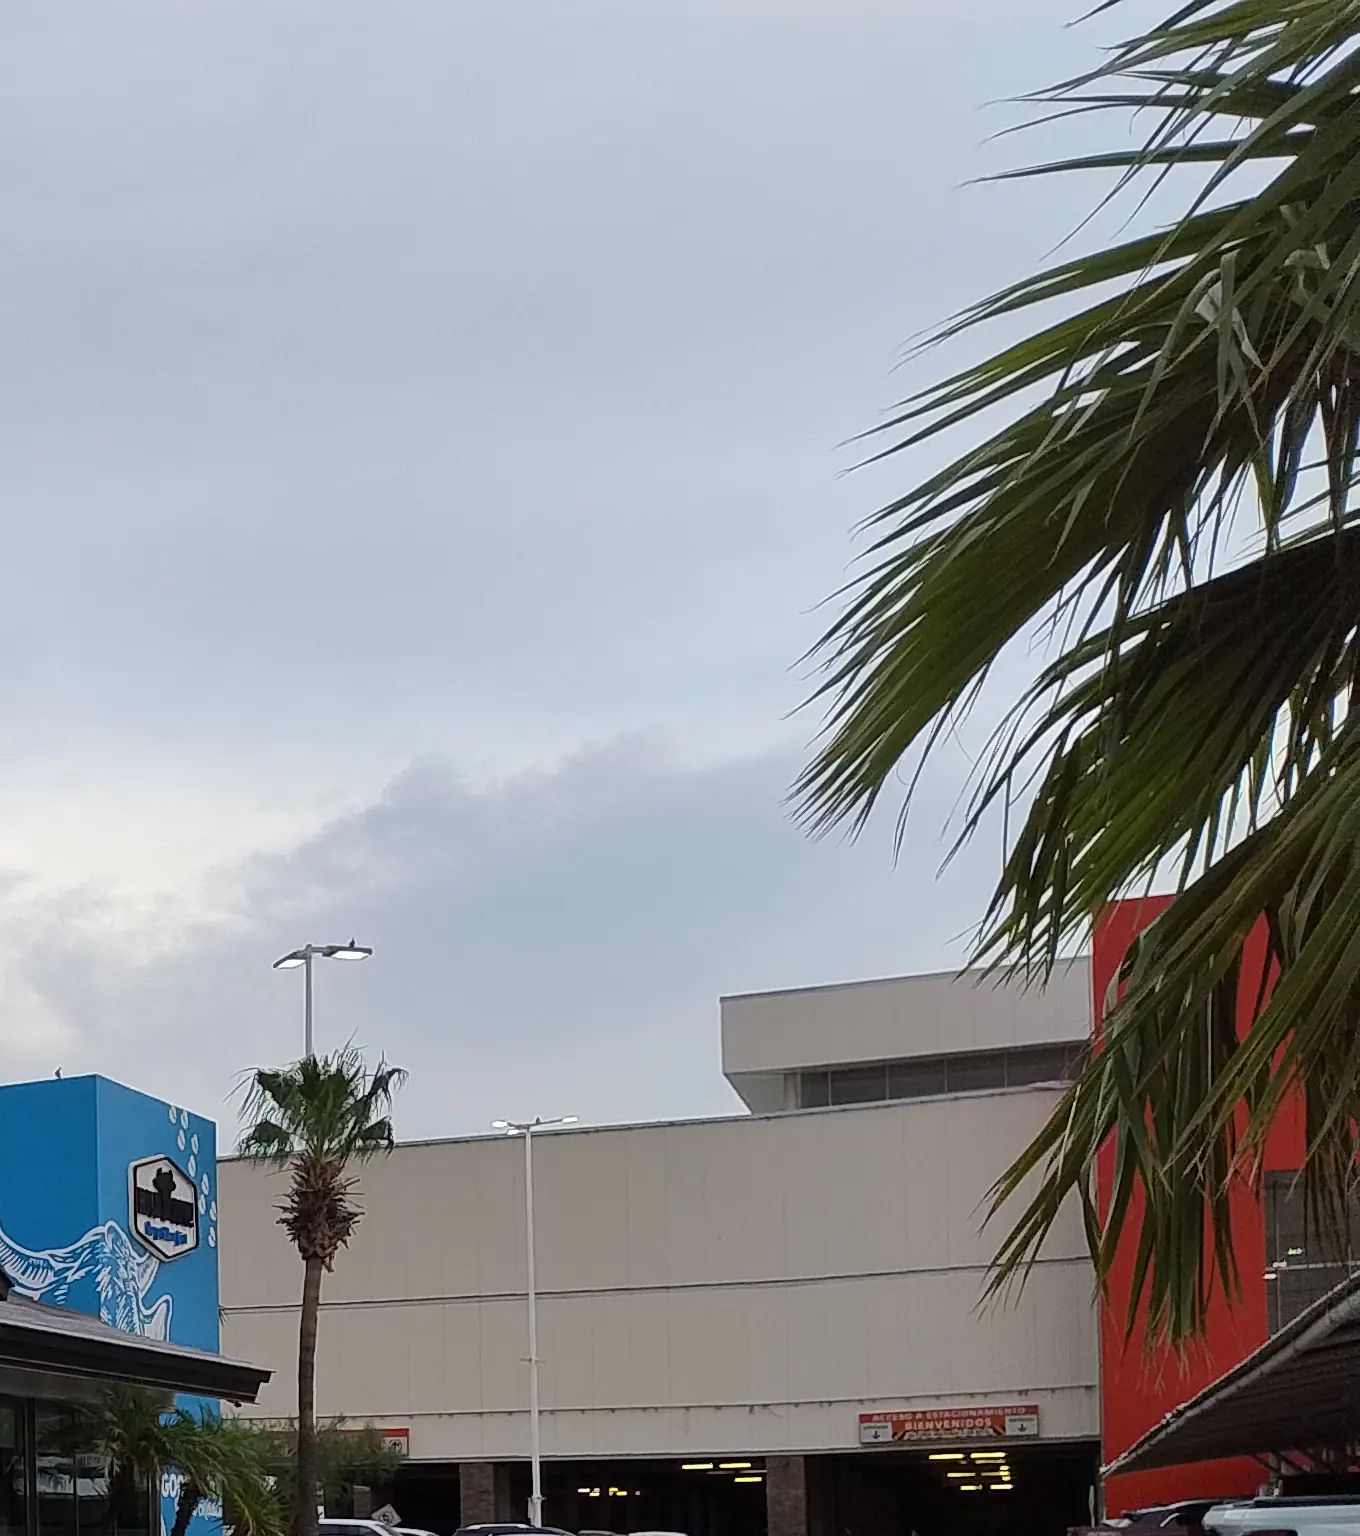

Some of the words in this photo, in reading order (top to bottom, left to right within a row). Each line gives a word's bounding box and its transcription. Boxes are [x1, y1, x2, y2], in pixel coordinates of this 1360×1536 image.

[871, 1412, 912, 1422] ACCESO
[926, 1406, 1026, 1419] ESTACIONAMIENTO
[904, 1417, 992, 1431] BIENVENIDOS
